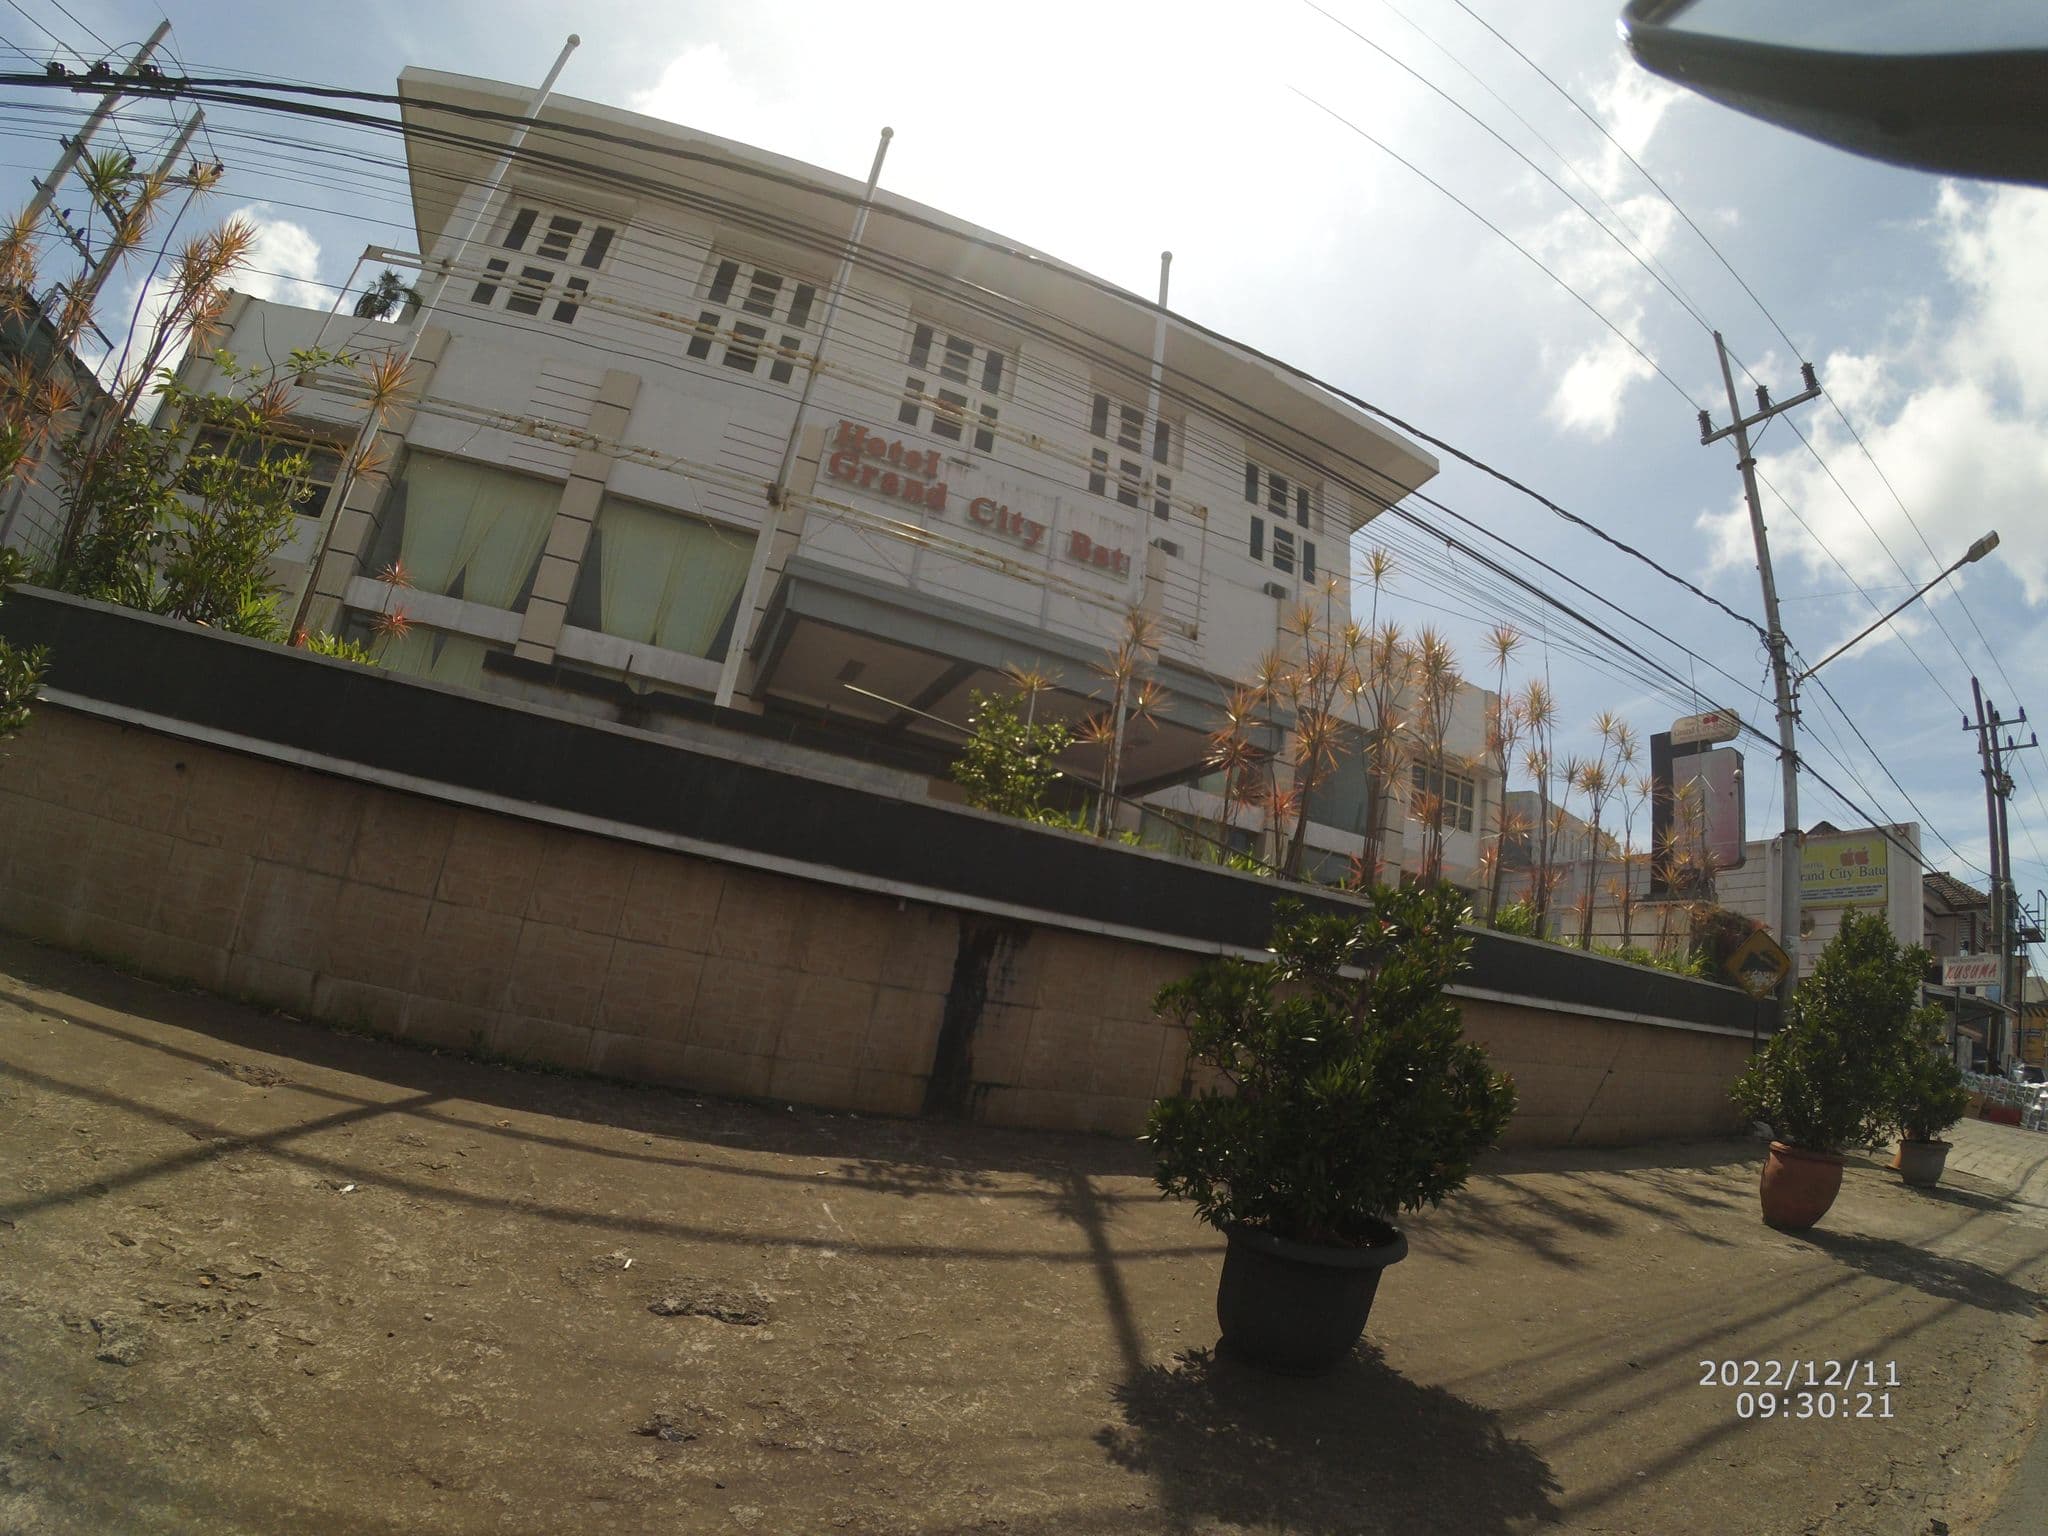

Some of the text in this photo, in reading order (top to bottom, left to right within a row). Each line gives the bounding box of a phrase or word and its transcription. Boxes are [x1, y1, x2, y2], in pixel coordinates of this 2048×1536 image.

[835, 418, 941, 480] Hotel
[829, 450, 1131, 577] Grand City Bat
[1800, 864, 1887, 881] rand City Batu
[1946, 962, 1998, 979] KUSUMA
